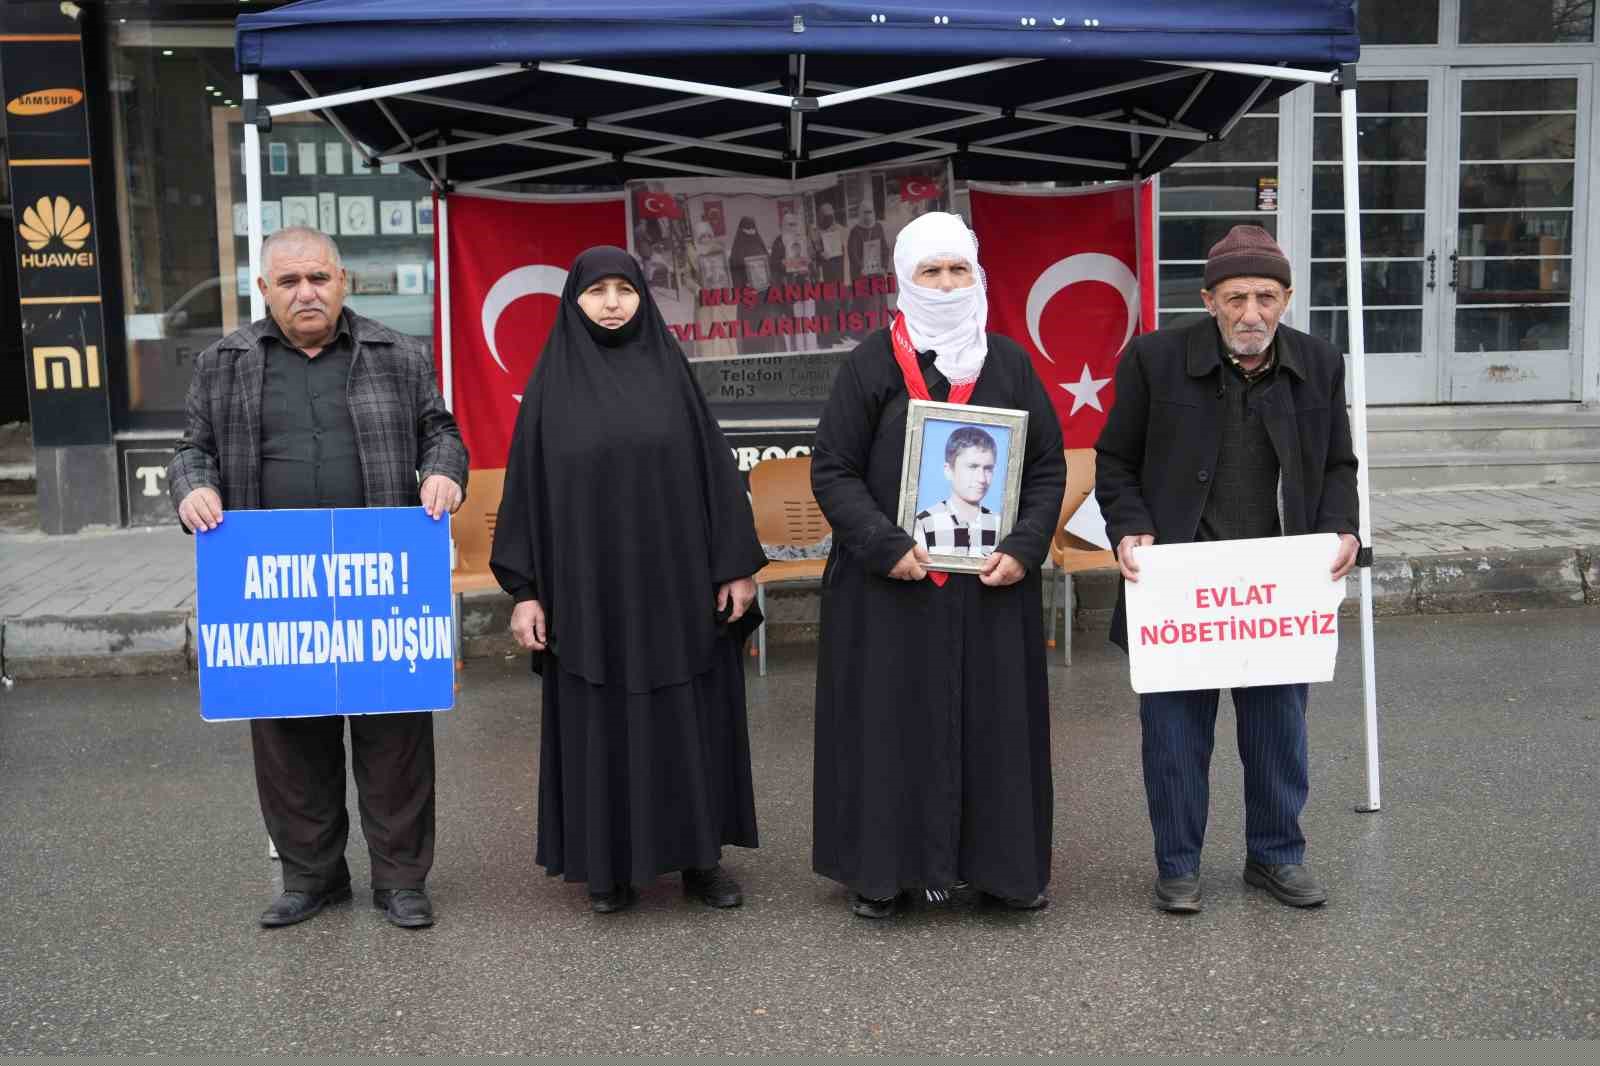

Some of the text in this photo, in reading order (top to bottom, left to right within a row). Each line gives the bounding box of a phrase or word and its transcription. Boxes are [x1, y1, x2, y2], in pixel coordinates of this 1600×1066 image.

[18, 95, 74, 105] SAMSUNG
[22, 253, 94, 268] HUAWEI
[699, 286, 759, 311] MUŞ
[667, 314, 831, 342] VLATLARINI
[720, 369, 783, 381] Telefon
[721, 385, 755, 399] Mp3
[244, 551, 409, 600] ARTIK YETER !
[1195, 584, 1277, 609] EVLAT
[200, 605, 451, 673] YAKAMIZDAN DÜŞÜN
[1140, 610, 1337, 646] NÖBETİNDEYİZ
